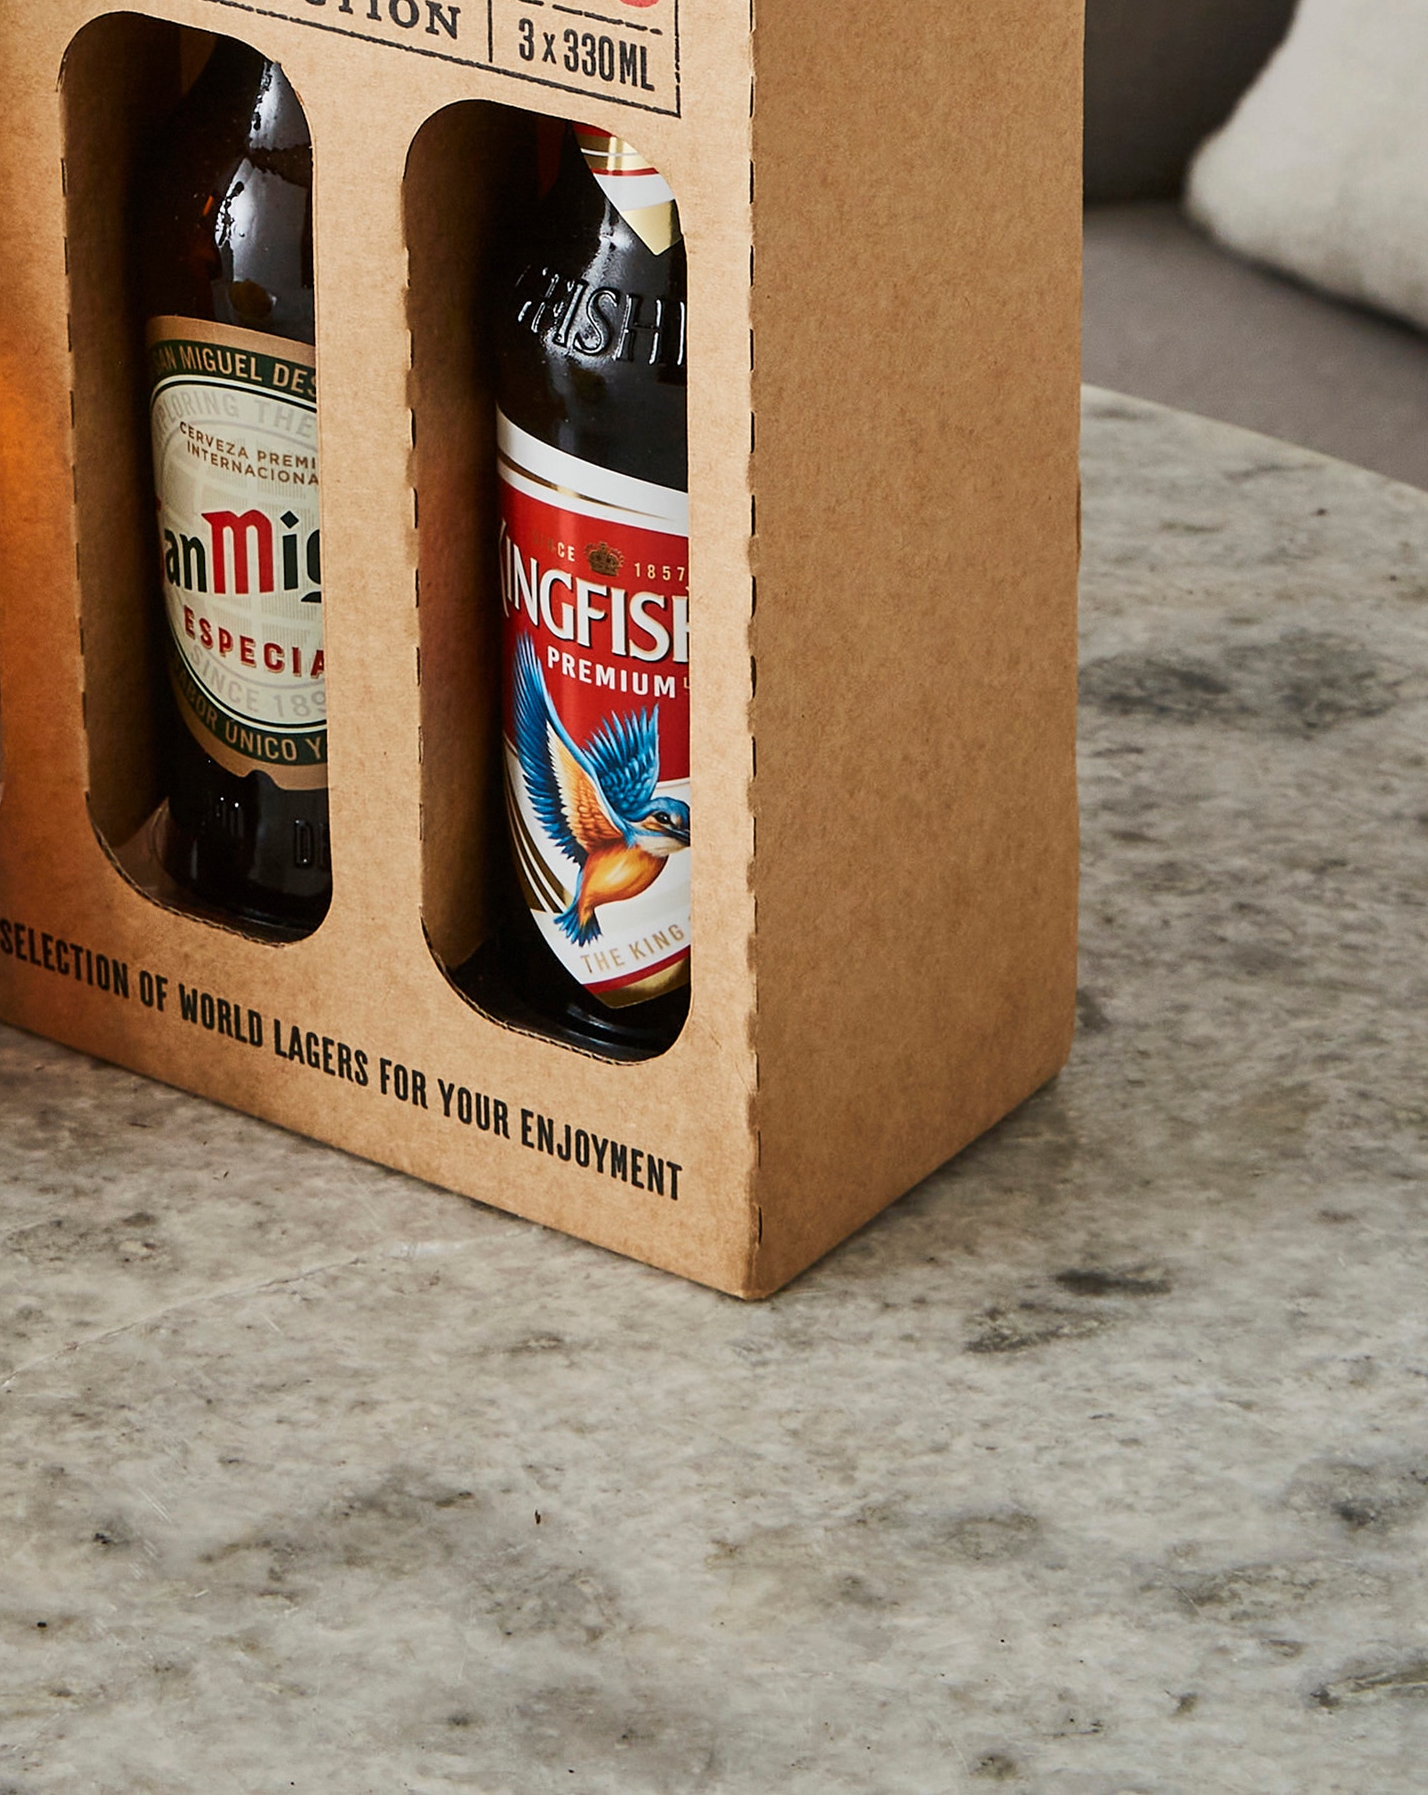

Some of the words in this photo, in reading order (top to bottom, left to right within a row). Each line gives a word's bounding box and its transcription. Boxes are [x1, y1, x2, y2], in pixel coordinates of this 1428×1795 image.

[517, 17, 535, 62] 3
[563, 27, 655, 93] 330ML
[179, 345, 263, 382] MIGUEL
[179, 421, 250, 460] CERVEZA
[254, 398, 317, 440] THE
[499, 518, 690, 664] INGFIS
[634, 562, 686, 582] 1857
[190, 644, 261, 713] SINCE
[546, 645, 677, 699] PREMIUM
[305, 736, 322, 760] Y
[579, 948, 625, 974] THE
[628, 924, 685, 960] KING
[139, 969, 169, 1012] OF
[178, 983, 264, 1048] WORLD
[273, 1018, 369, 1087] LAGERS
[379, 1057, 429, 1110] FOR
[437, 1078, 511, 1140] YOUR
[521, 1108, 683, 1201] ENJOYMENT
